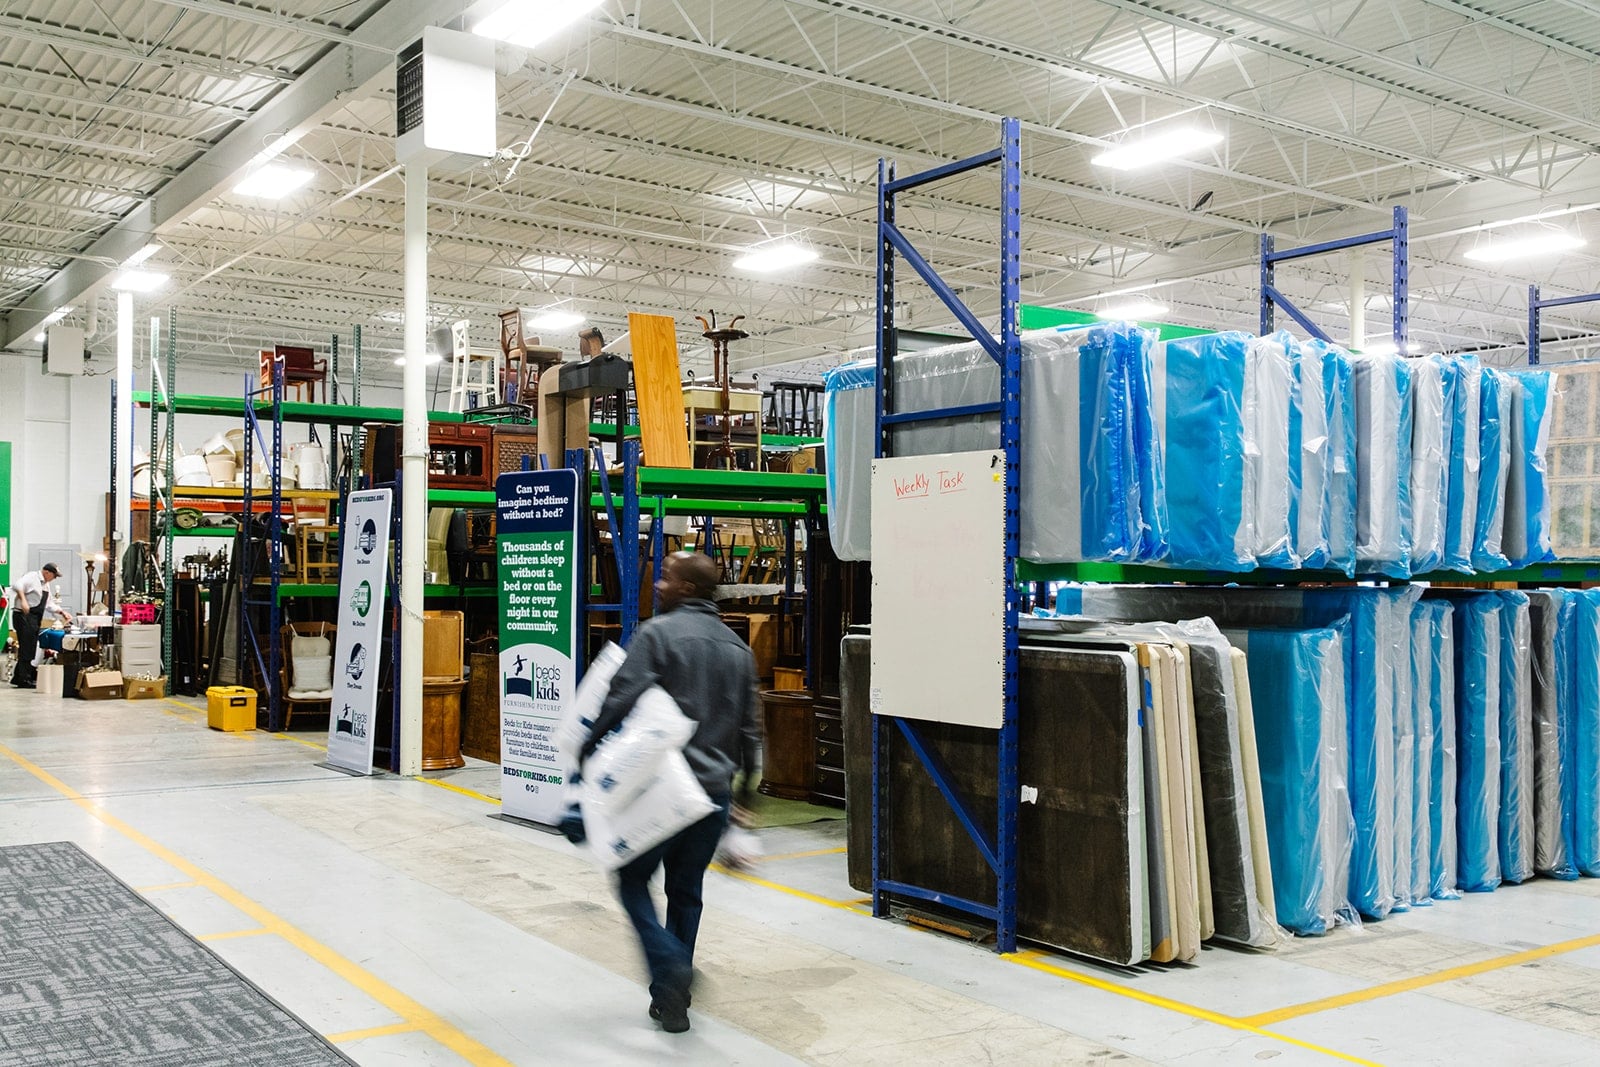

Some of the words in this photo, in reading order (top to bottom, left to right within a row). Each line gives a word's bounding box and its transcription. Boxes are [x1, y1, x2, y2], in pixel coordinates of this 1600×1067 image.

[516, 484, 533, 494] Can
[534, 485, 550, 496] you
[893, 472, 930, 497] Weekly
[936, 470, 965, 491] Task
[498, 497, 532, 509] imagine
[533, 494, 569, 506] bedtime
[503, 509, 534, 520] without
[535, 510, 541, 519] a
[542, 507, 564, 518] bed?
[502, 540, 552, 552] Thousands
[554, 539, 565, 551] of
[501, 554, 539, 565] children
[540, 553, 565, 567] sleep
[511, 567, 546, 578] without
[547, 569, 554, 578] a
[503, 580, 521, 591] bed
[522, 583, 532, 591] or
[533, 583, 547, 591] on
[547, 580, 562, 591] the
[509, 593, 531, 604] floor
[531, 596, 556, 607] every
[507, 606, 530, 620] night
[531, 606, 541, 617] in
[542, 609, 559, 618] our
[506, 620, 559, 635] community.
[535, 663, 561, 681] beds
[536, 680, 560, 701] kids
[504, 718, 516, 728] Beds
[522, 720, 533, 730] Kids
[520, 730, 532, 739] beds
[530, 741, 550, 752] children
[503, 766, 563, 785] BEDSFORKIDS.ORG
